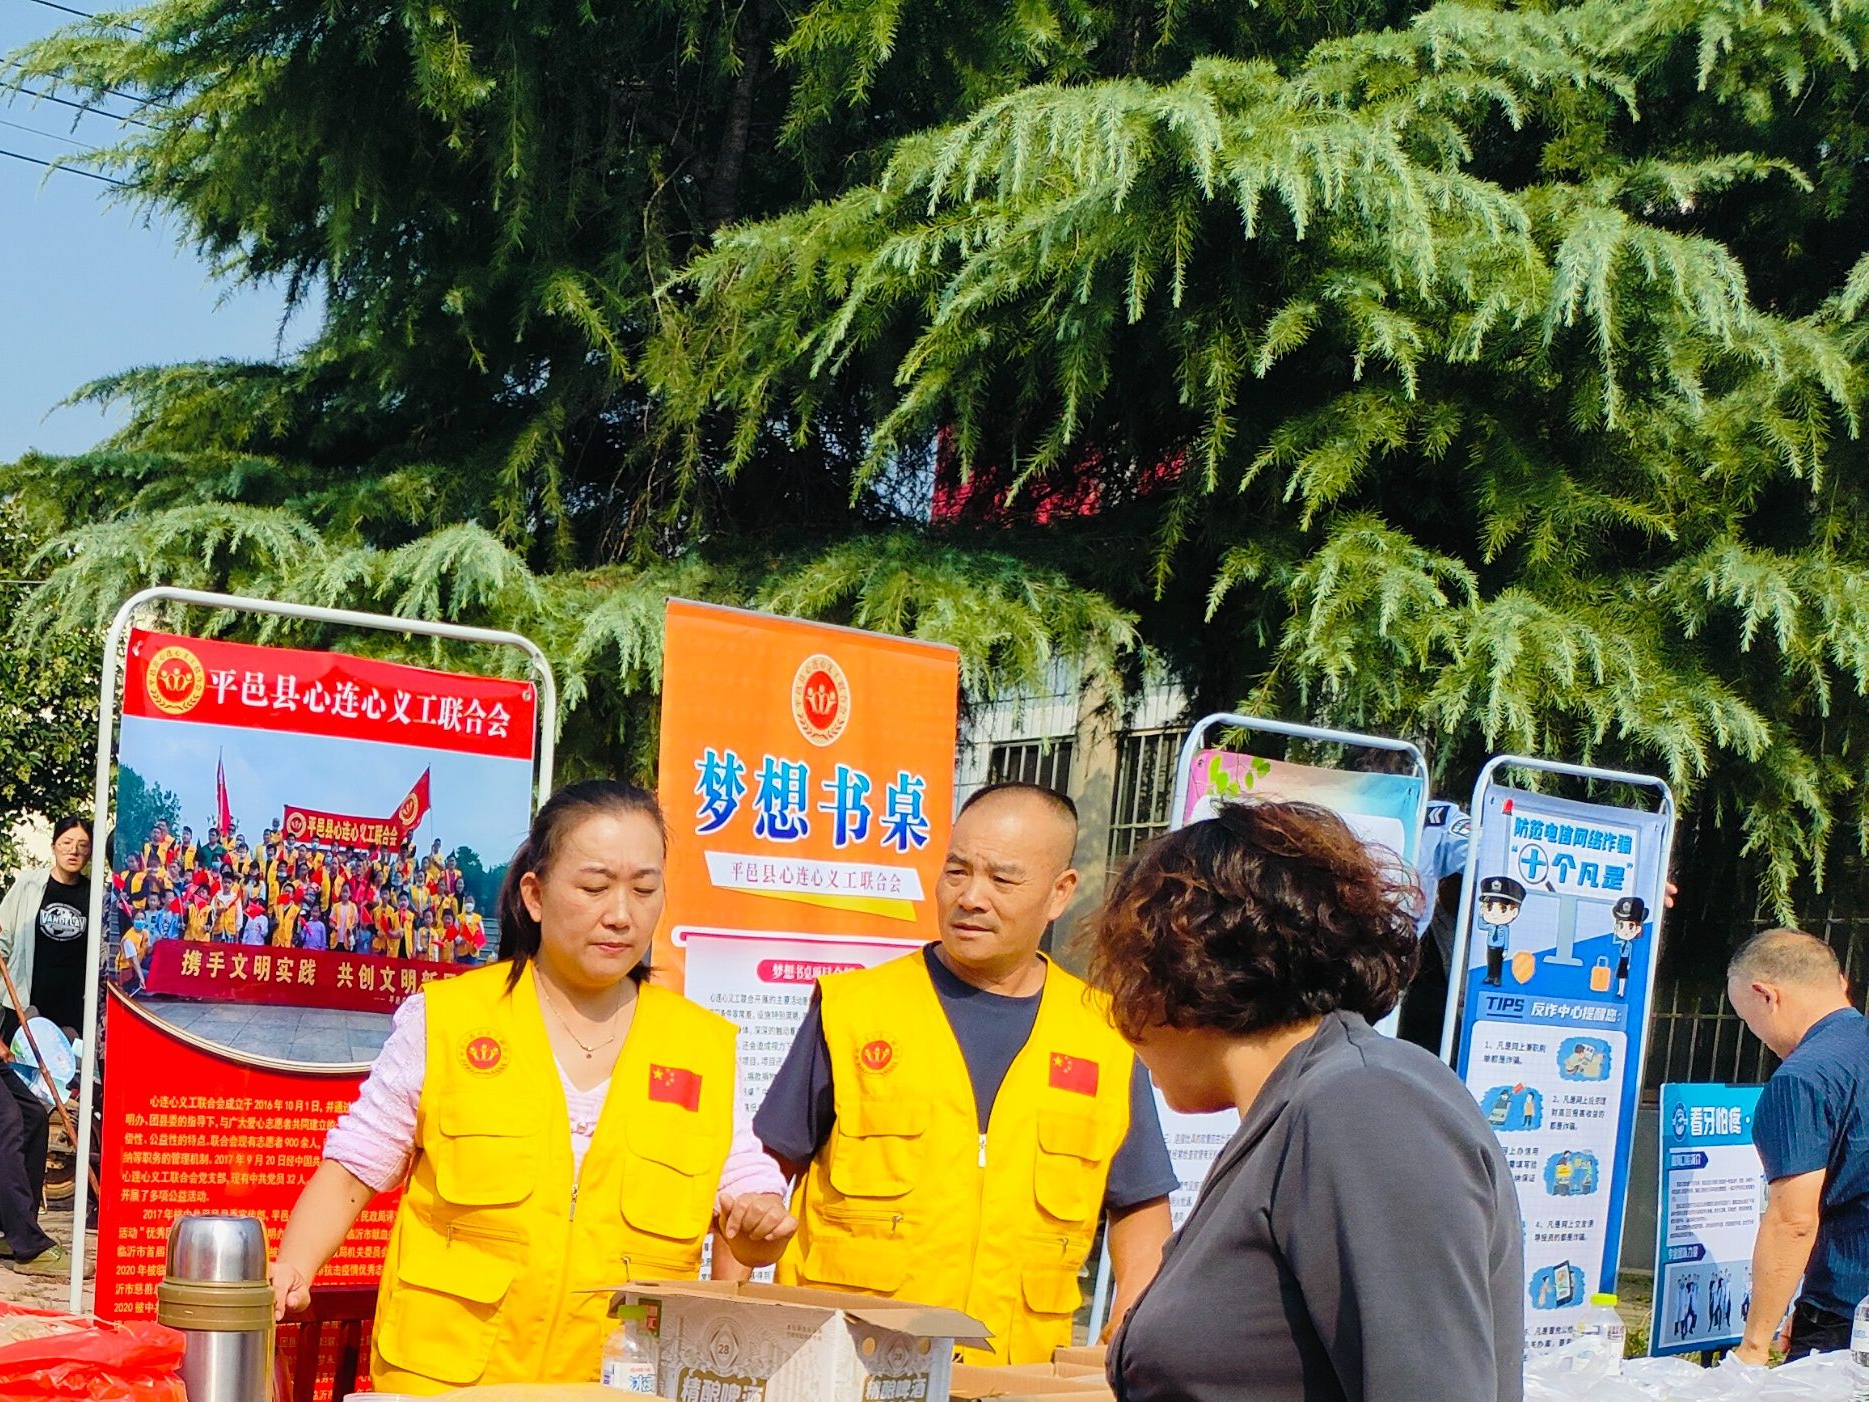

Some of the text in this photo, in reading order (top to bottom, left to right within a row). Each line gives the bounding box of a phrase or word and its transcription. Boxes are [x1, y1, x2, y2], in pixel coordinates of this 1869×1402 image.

[207, 667, 511, 738] 平邑县心连心义工联合会
[693, 748, 930, 853] 梦想书桌
[307, 815, 399, 847] 平邑县心连心义工联合会
[1513, 816, 1633, 855] 防范电信网络诈骗
[731, 861, 902, 894] 平邑县心连心义工联合会
[1511, 845, 1633, 891] “十个凡是”
[180, 949, 317, 986] 携手文明实践
[772, 963, 856, 980] 梦想书桌项目
[1486, 996, 1525, 1012] TIPS
[718, 1345, 730, 1355] 28
[866, 1378, 926, 1400] 精酿啤酒
